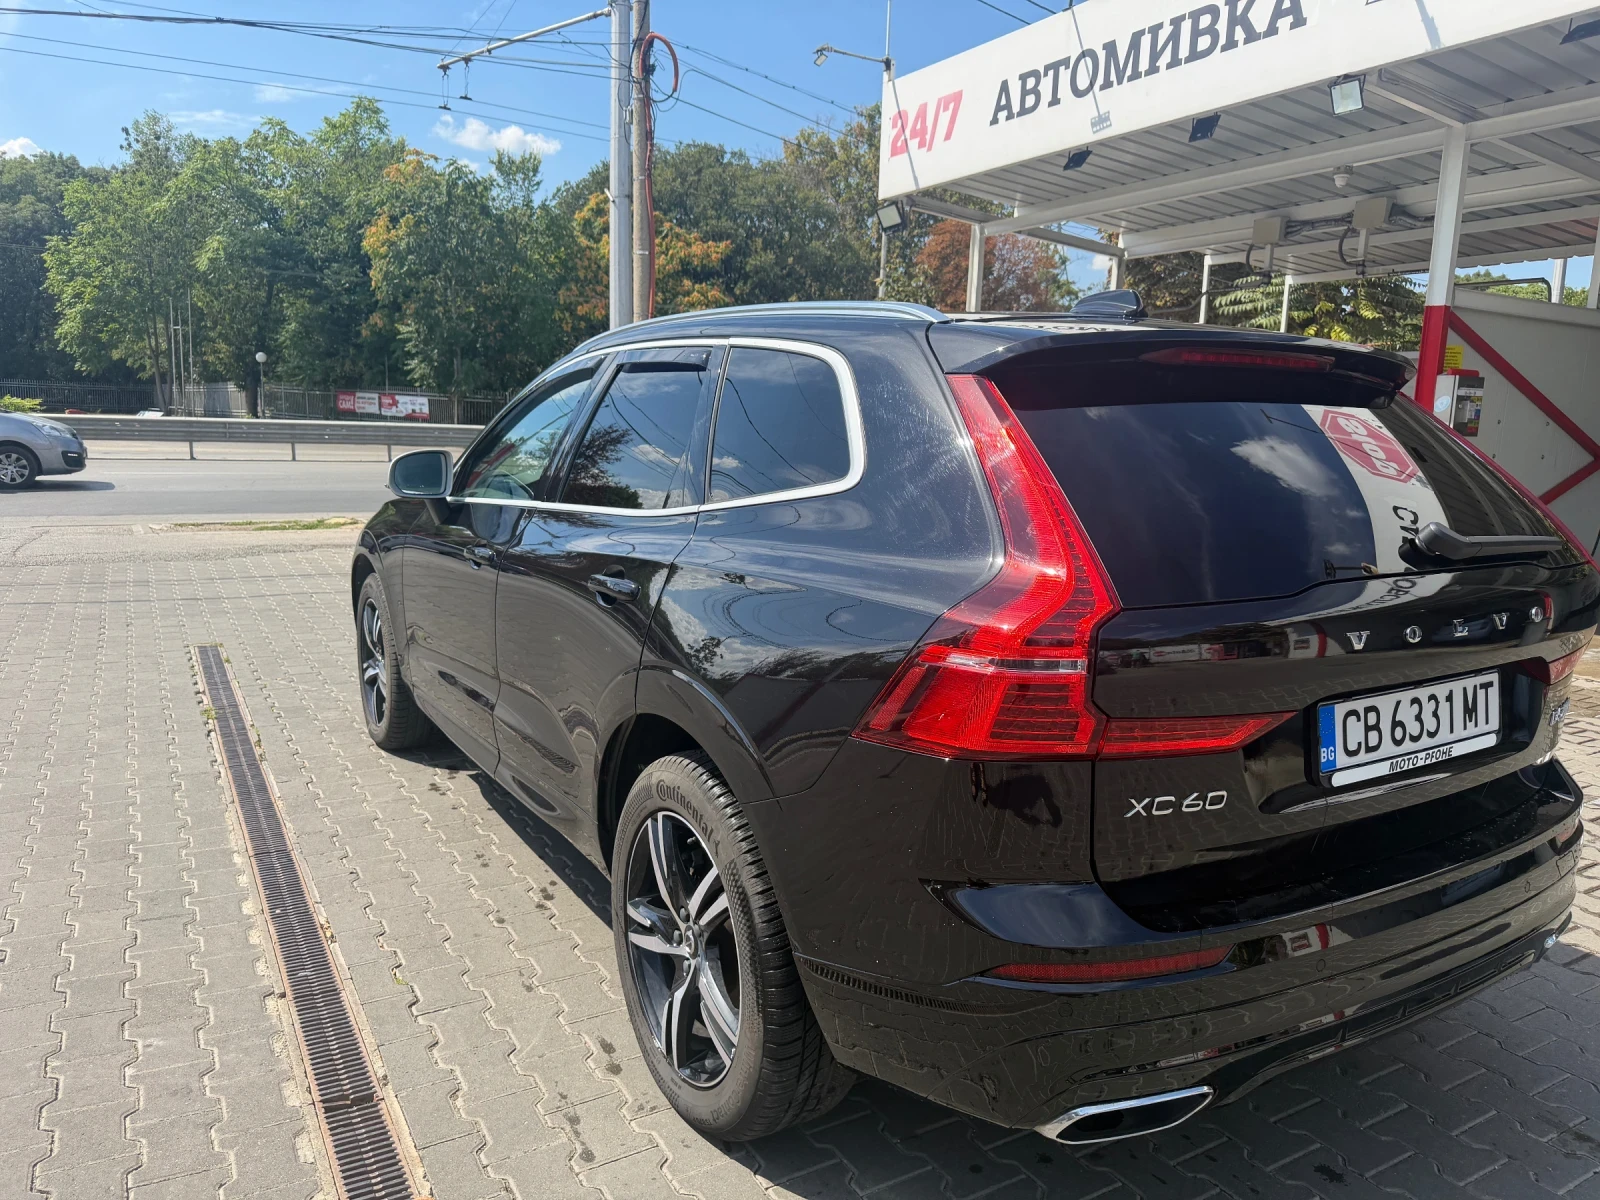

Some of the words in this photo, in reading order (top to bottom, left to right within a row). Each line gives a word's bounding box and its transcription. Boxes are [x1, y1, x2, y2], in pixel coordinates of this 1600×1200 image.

[890, 89, 963, 158] 24/7
[989, 0, 1307, 126] АВТОМИВКА
[1345, 606, 1544, 651] VOLVO
[1342, 704, 1383, 757] CB
[1390, 689, 1455, 748] 6331
[1462, 681, 1494, 732] MT
[1320, 747, 1335, 763] BG
[1388, 746, 1454, 773] MOTO-PFOHE
[656, 778, 714, 844] Continental
